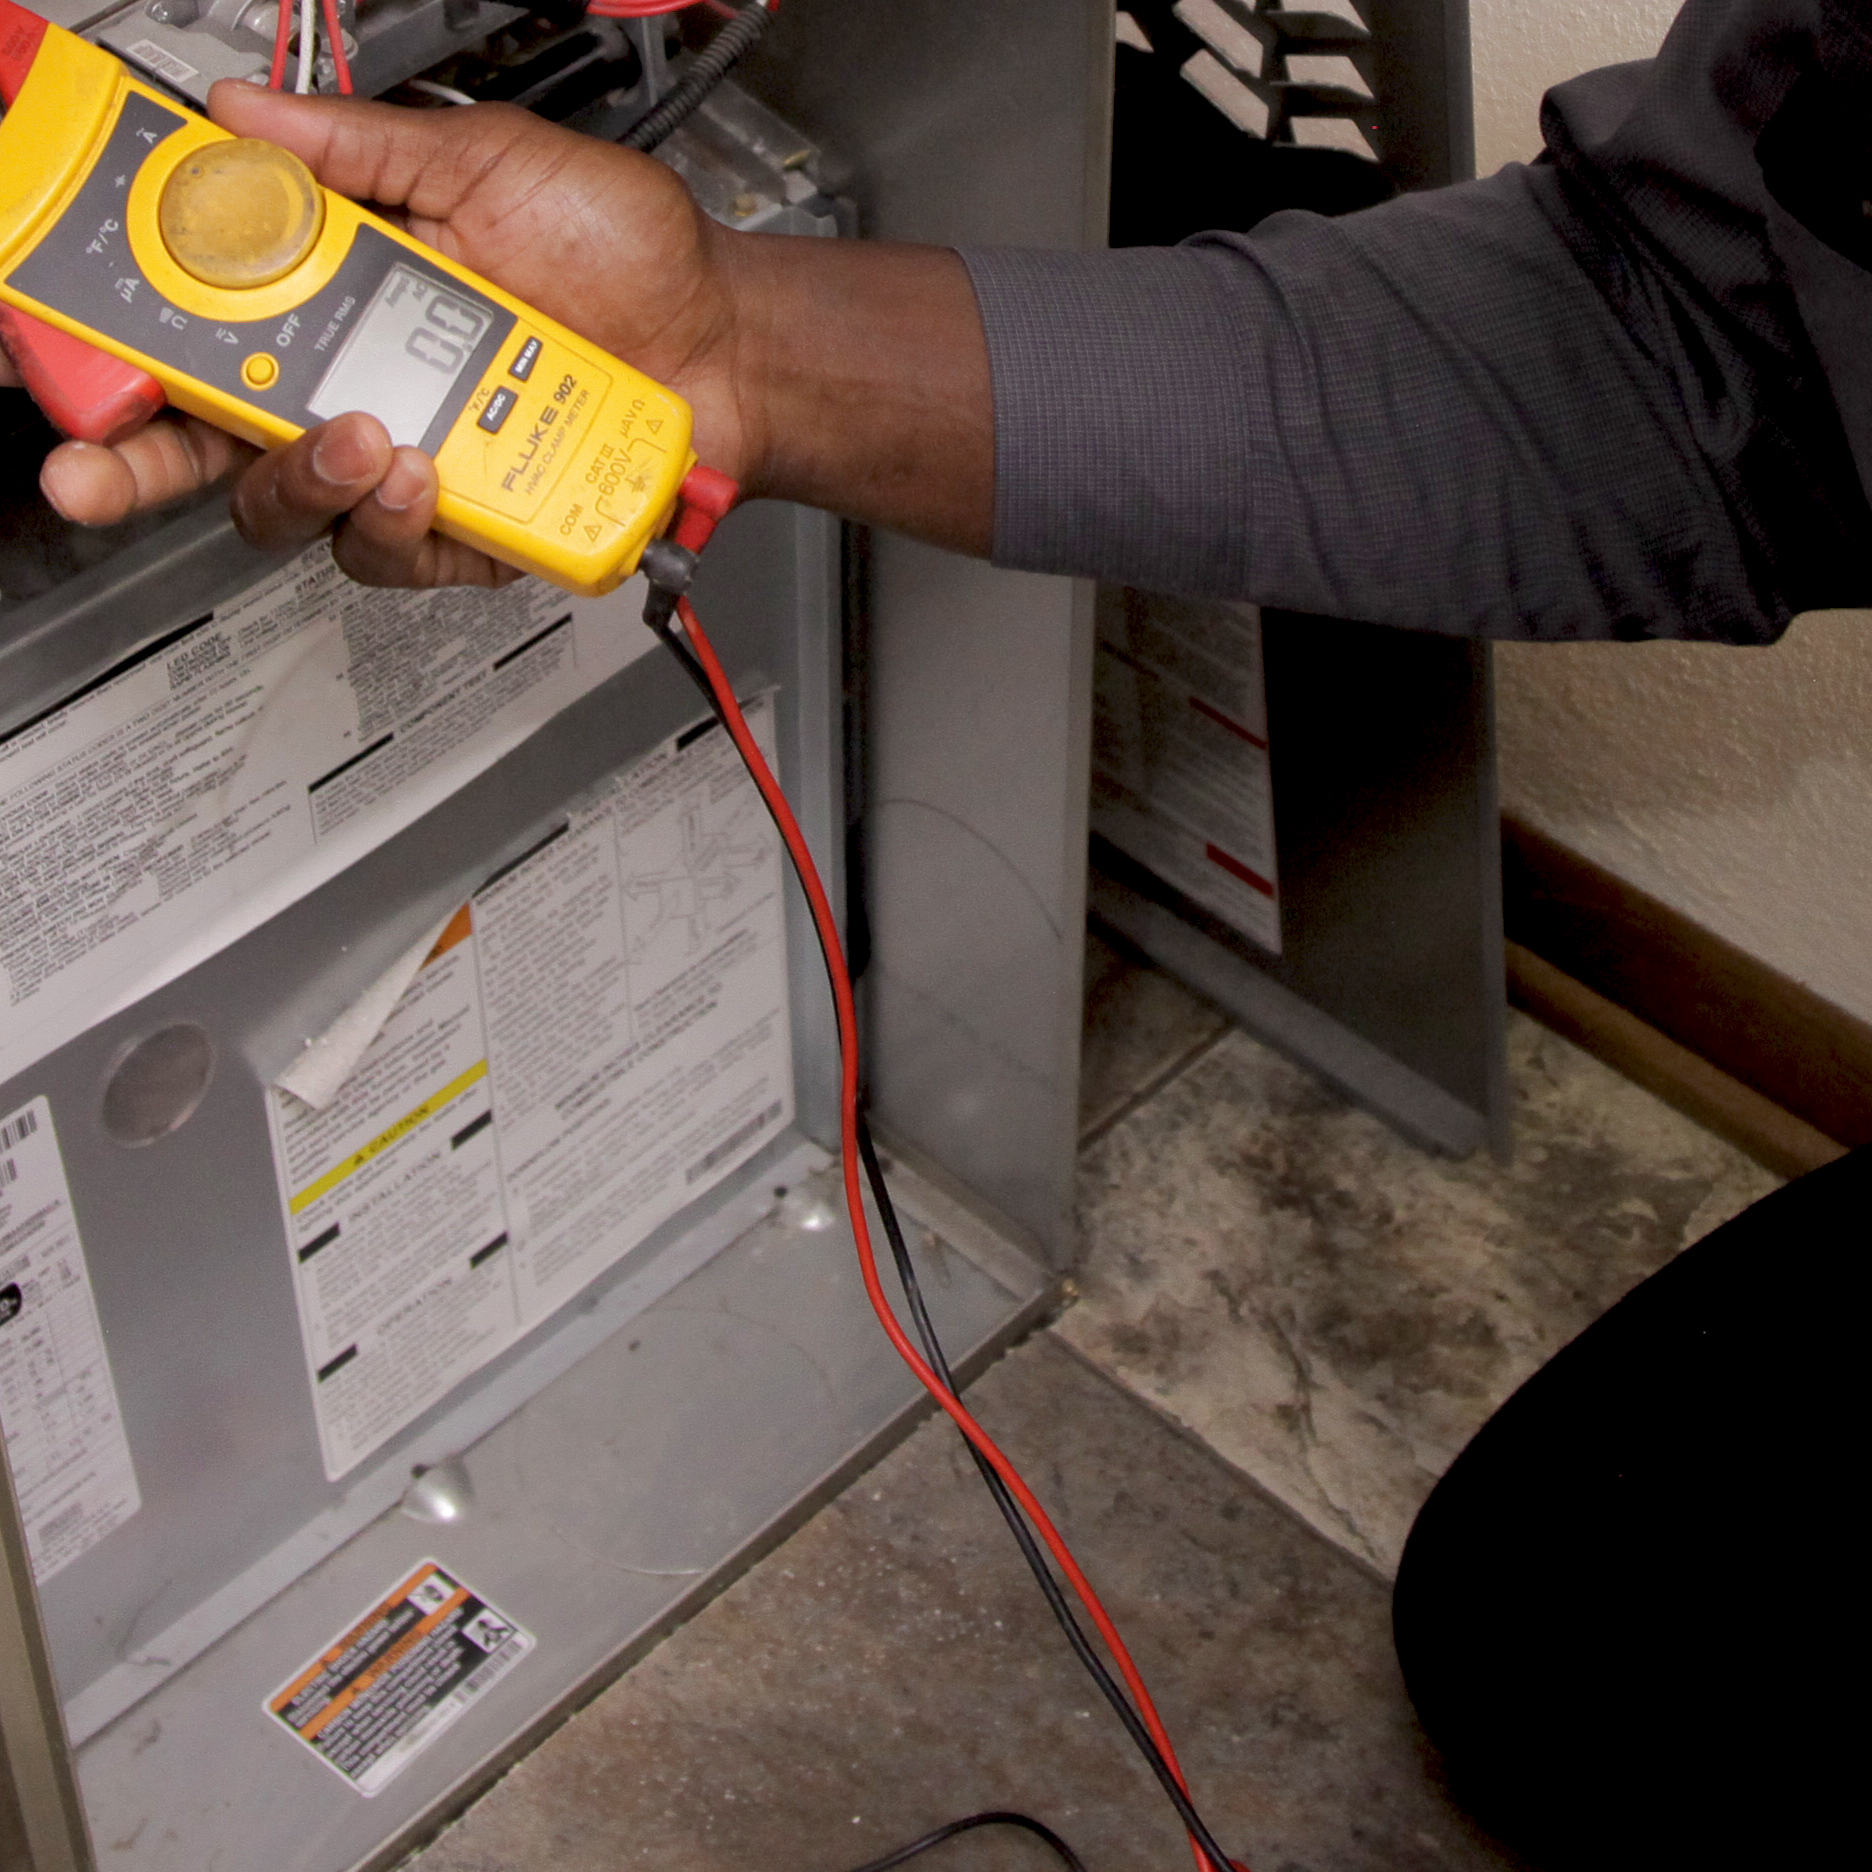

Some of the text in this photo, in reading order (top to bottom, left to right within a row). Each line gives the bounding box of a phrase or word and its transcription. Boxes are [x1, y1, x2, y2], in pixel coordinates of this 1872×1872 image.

[276, 314, 302, 348] OFF
[314, 295, 357, 353] TRUE RMS
[514, 339, 540, 375] MIN MAX
[485, 392, 507, 422] AC/DC
[500, 374, 578, 493] FLUKE 902
[525, 389, 590, 496] HVAC CLAMP METER
[584, 458, 606, 485] CAT
[598, 448, 632, 498] 600V
[559, 503, 585, 537] COM
